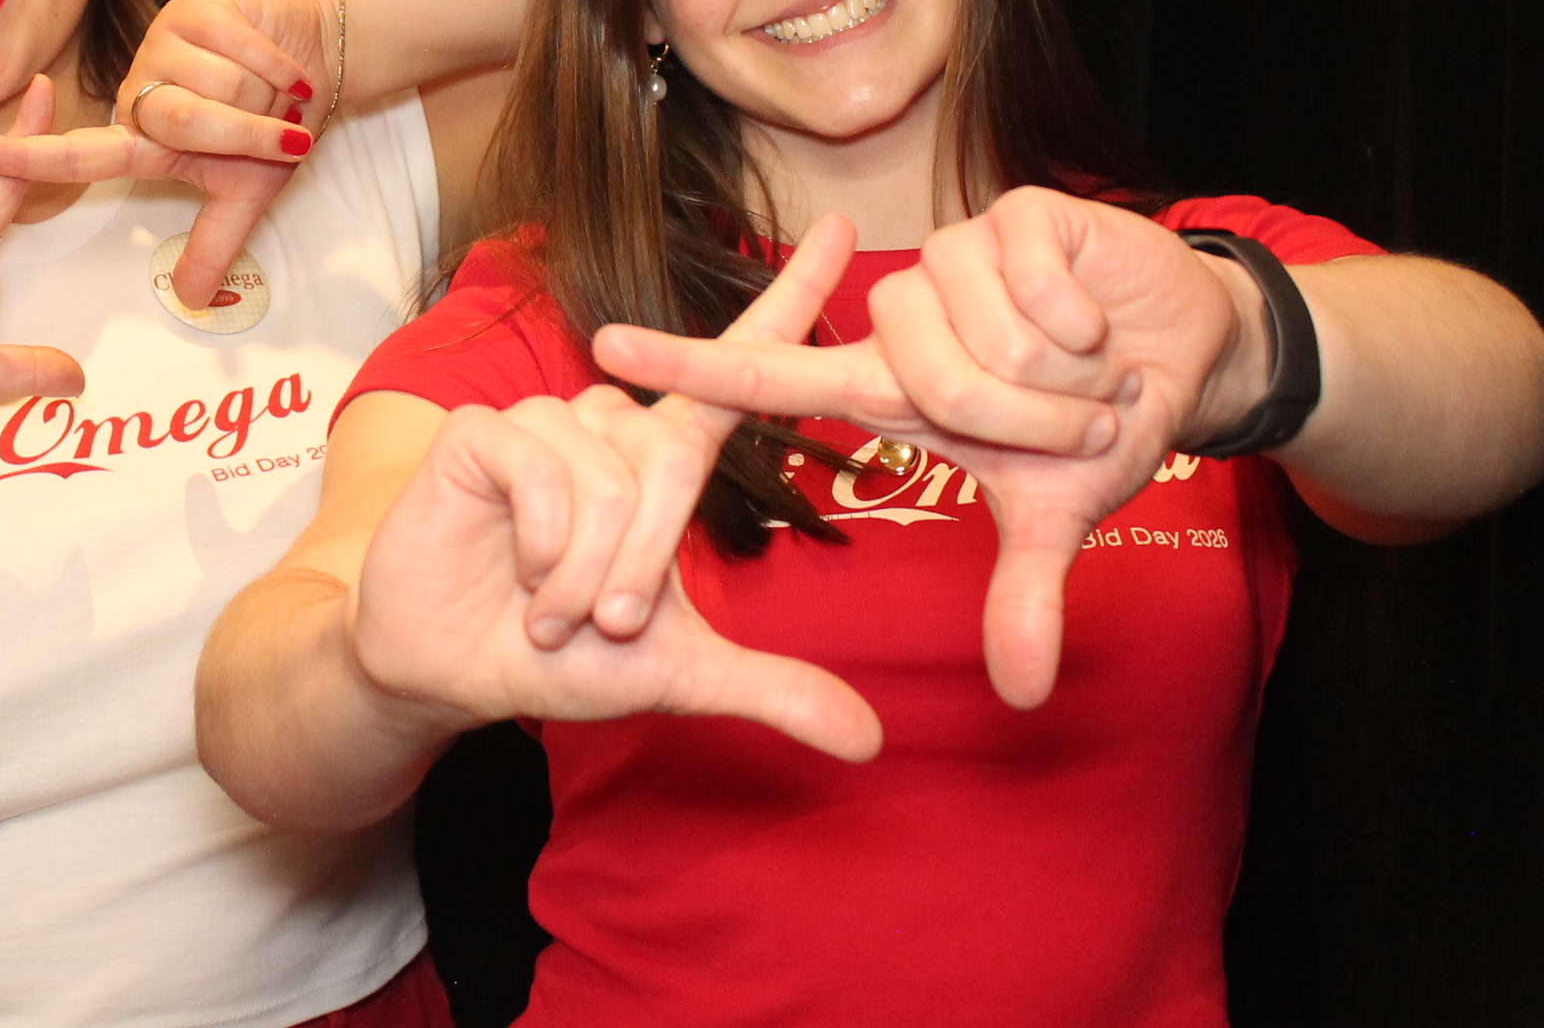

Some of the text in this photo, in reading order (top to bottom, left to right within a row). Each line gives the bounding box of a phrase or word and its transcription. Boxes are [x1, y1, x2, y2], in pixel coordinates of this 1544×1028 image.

[211, 463, 251, 482] Bid
[256, 454, 299, 472] Day
[1130, 527, 1179, 549] Day
[1186, 528, 1229, 548] 2026
